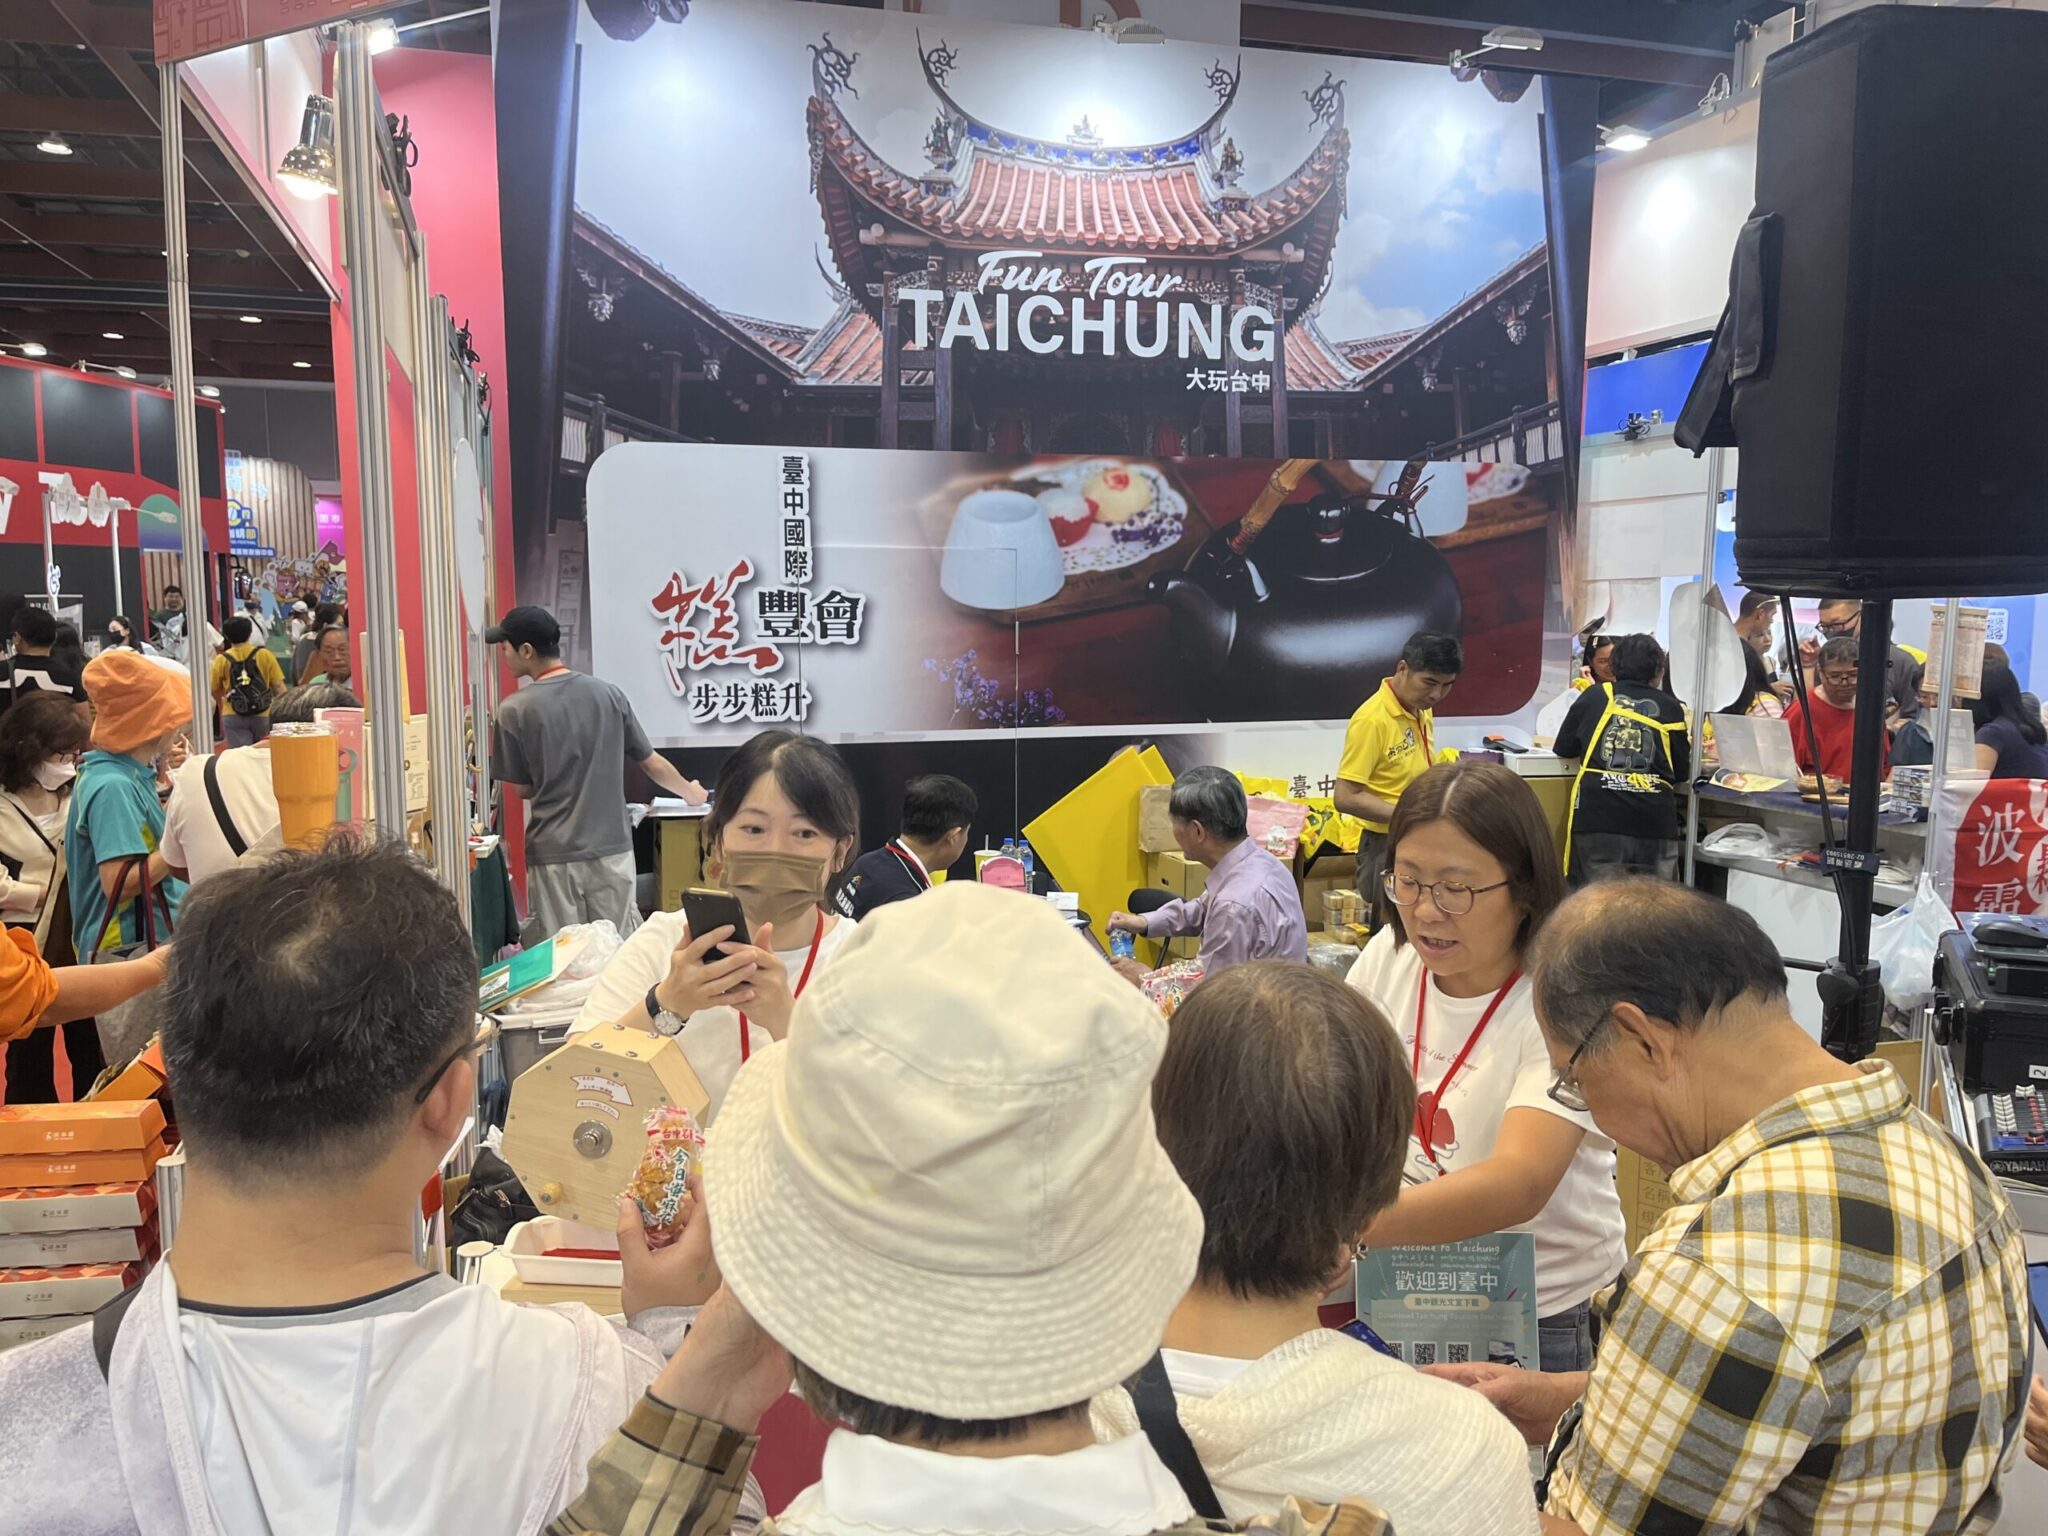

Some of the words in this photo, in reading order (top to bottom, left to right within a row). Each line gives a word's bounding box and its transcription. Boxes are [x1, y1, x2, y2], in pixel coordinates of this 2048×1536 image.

[978, 250, 1063, 295] Fun
[1084, 256, 1183, 301] Tour
[898, 287, 1276, 362] TAICHUNG
[1186, 367, 1271, 394] 大玩台中
[782, 455, 808, 579] 臺中國際
[692, 682, 808, 718] 步步糕升
[1456, 1240, 1500, 1255] Taichung
[1394, 1270, 1498, 1293] 歡迎到臺中
